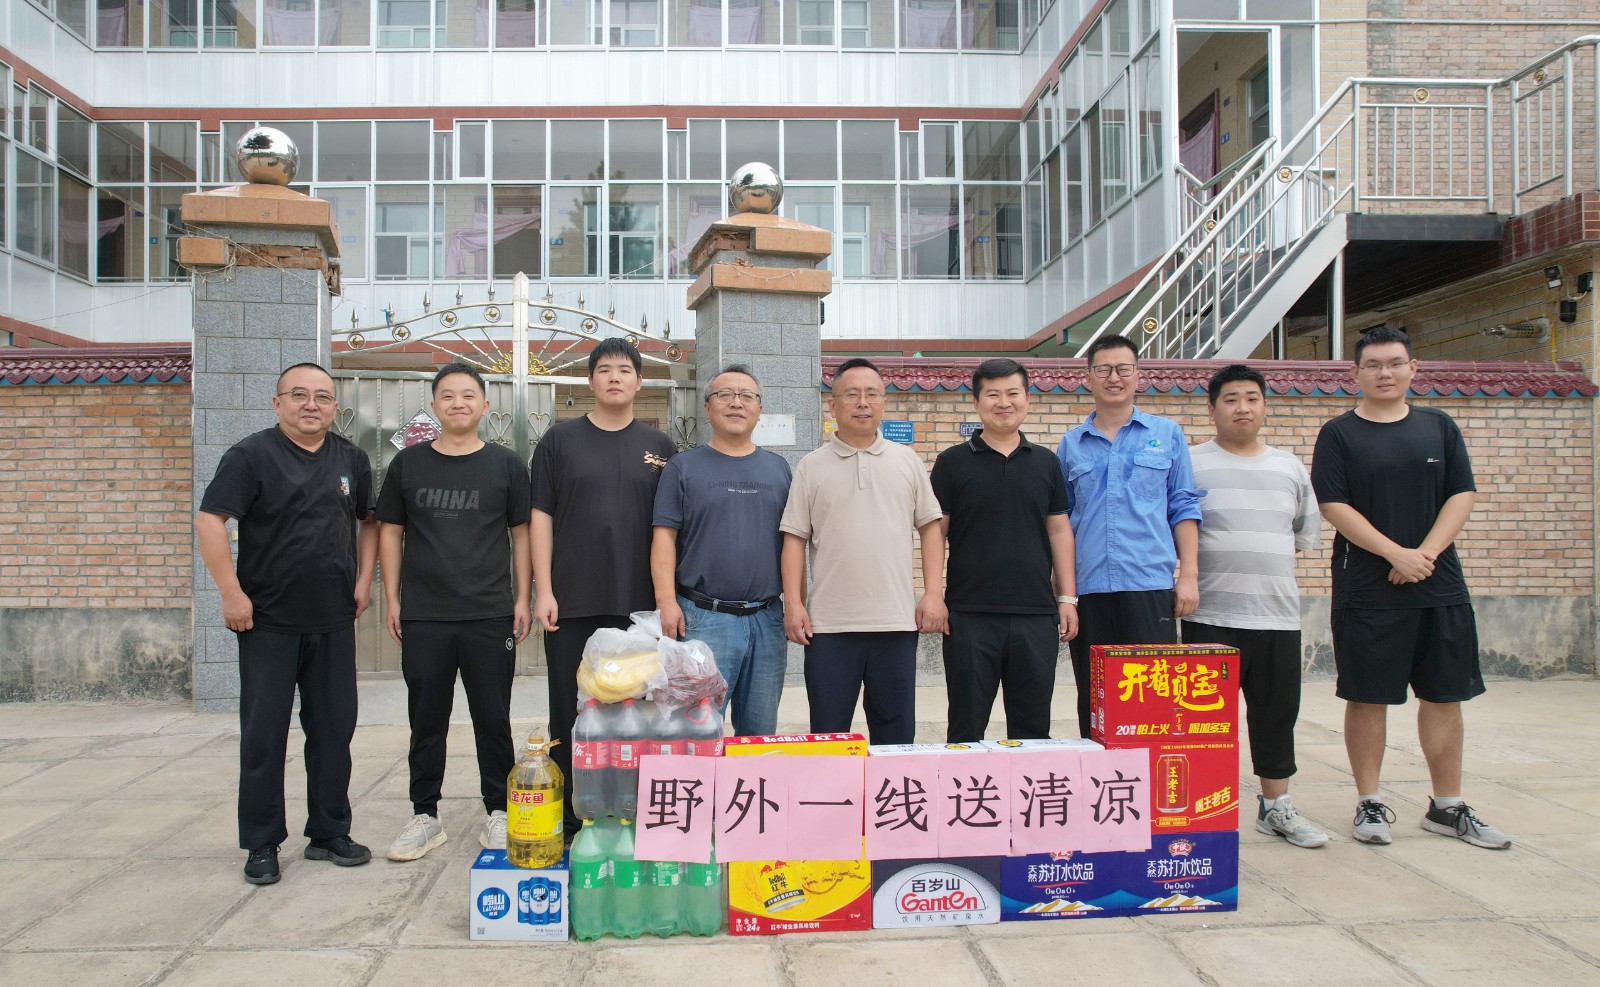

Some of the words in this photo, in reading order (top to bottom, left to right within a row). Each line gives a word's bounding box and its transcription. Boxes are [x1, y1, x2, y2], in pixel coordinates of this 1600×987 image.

[415, 488, 480, 509] CHINA
[1136, 723, 1170, 736] 怕上火
[1187, 722, 1231, 734] 喝加多宝
[762, 735, 808, 743] RedBull
[1168, 766, 1178, 804] 王老吉
[511, 790, 544, 804] 金龙鱼
[645, 769, 1141, 834] 野外一线送清凉
[1038, 863, 1094, 882] 苏打水饮品
[1157, 858, 1212, 877] 苏打水饮品
[771, 880, 788, 892] 红牛
[912, 878, 960, 892] 百岁山
[901, 913, 984, 923] 饮用天然矿泉水
